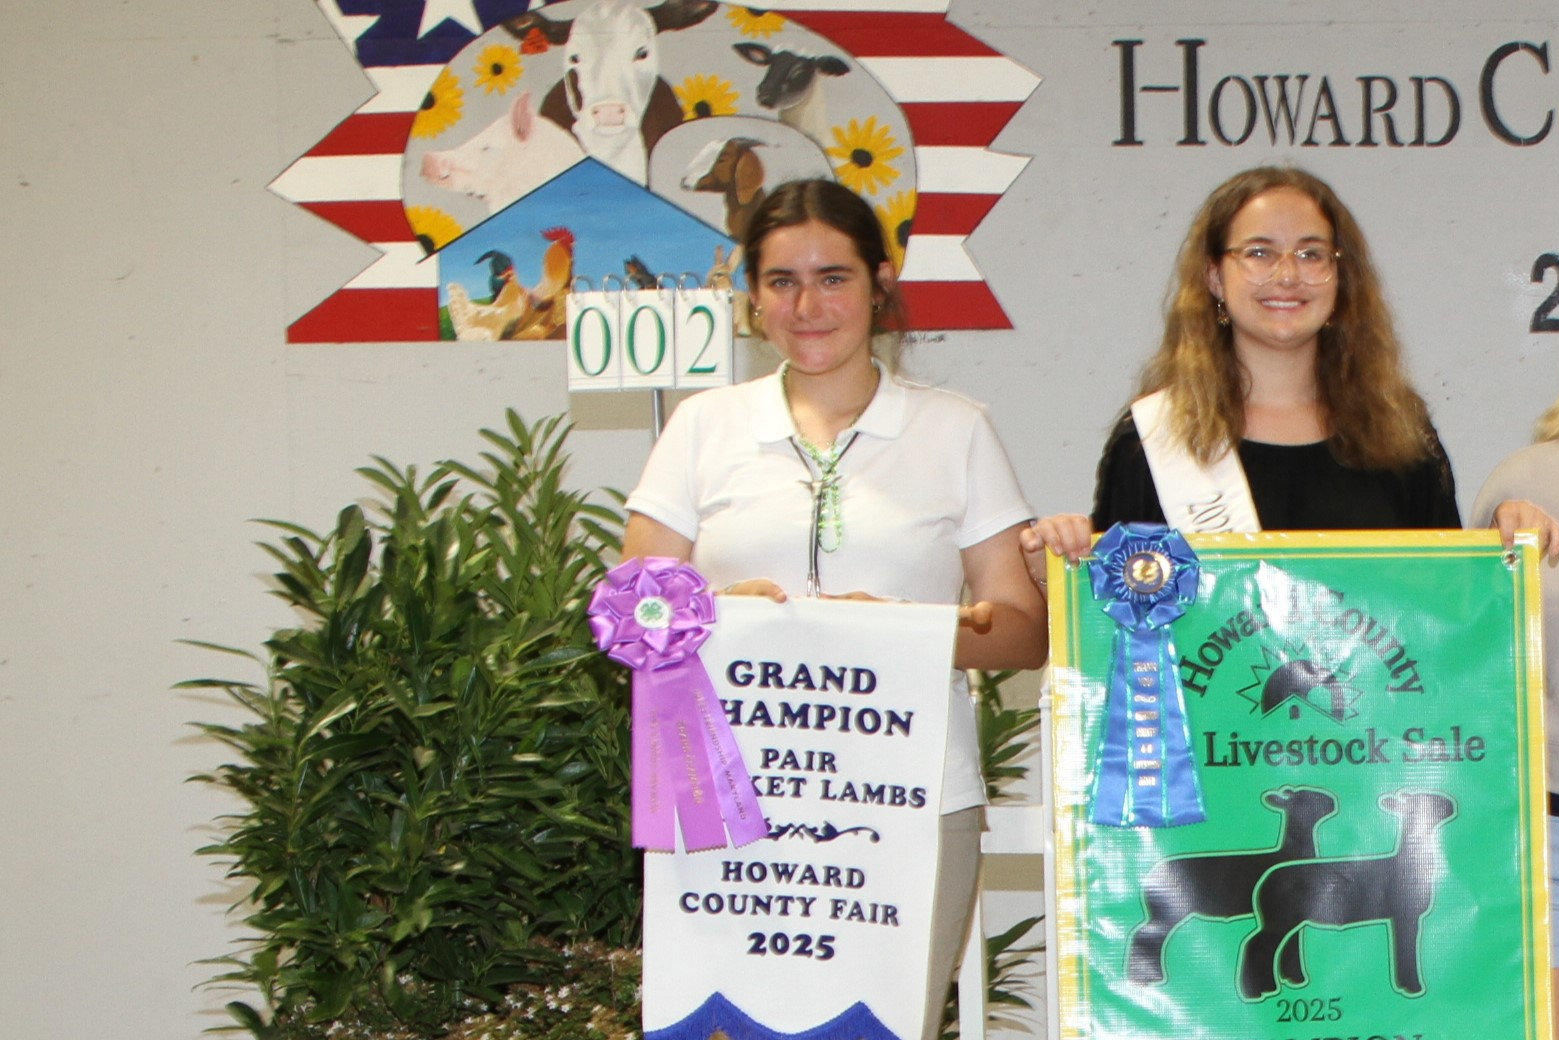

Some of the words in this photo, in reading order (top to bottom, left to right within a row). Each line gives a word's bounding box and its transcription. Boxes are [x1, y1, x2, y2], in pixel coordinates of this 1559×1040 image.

[1112, 38, 1463, 149] HOWARD
[571, 305, 719, 378] 002
[725, 660, 878, 695] GRAND
[718, 698, 915, 738] HAMPION
[759, 747, 839, 774] PAIR
[1203, 727, 1390, 767] Livestock
[1401, 724, 1487, 764] Sale
[750, 775, 808, 799] KET
[820, 778, 927, 809] LAMBS
[721, 860, 866, 890] HOWARD
[678, 891, 817, 919] COUNTY
[828, 898, 900, 928] FAIR
[746, 931, 837, 962] 2025
[1275, 998, 1343, 1024] 2025
